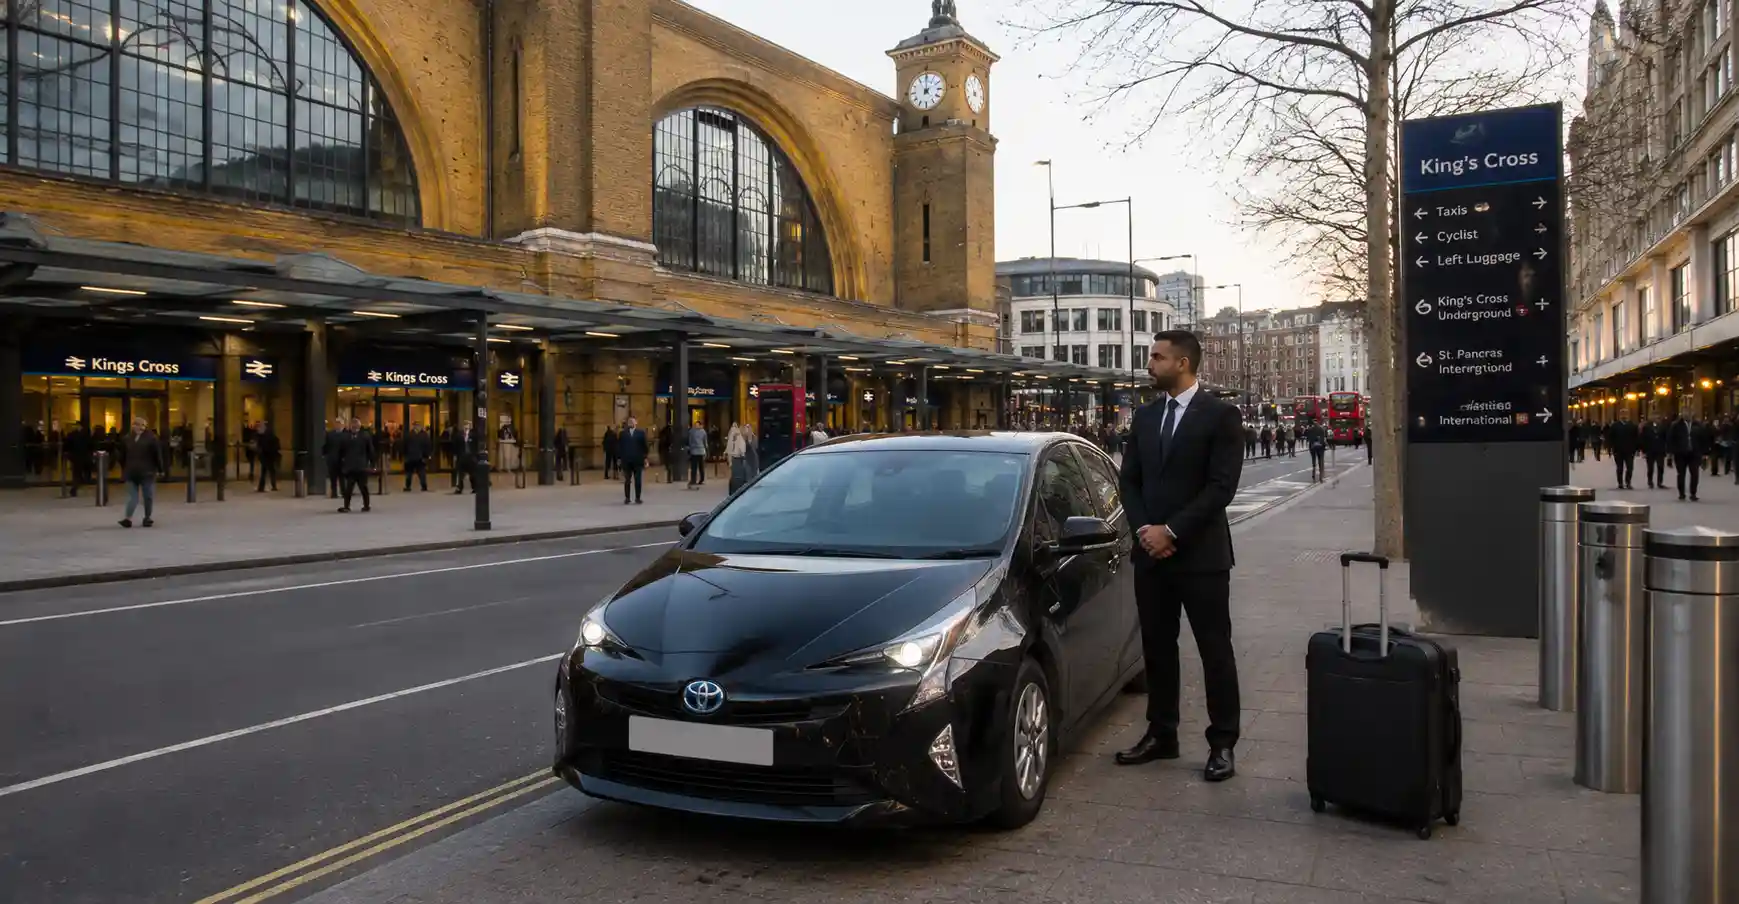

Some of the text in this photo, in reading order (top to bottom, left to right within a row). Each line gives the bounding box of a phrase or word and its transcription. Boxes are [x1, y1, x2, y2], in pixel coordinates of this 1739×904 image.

[1421, 152, 1539, 175] King's Cross
[1436, 205, 1468, 217] Taxis
[1437, 229, 1479, 243] Cyclist
[1437, 252, 1521, 266] Left Luggage
[1438, 294, 1508, 307] King's Cross
[1438, 349, 1503, 360] St. Pancras
[92, 358, 179, 374] Kings Cross
[385, 371, 448, 385] Kings Cross
[1439, 414, 1512, 425] International
